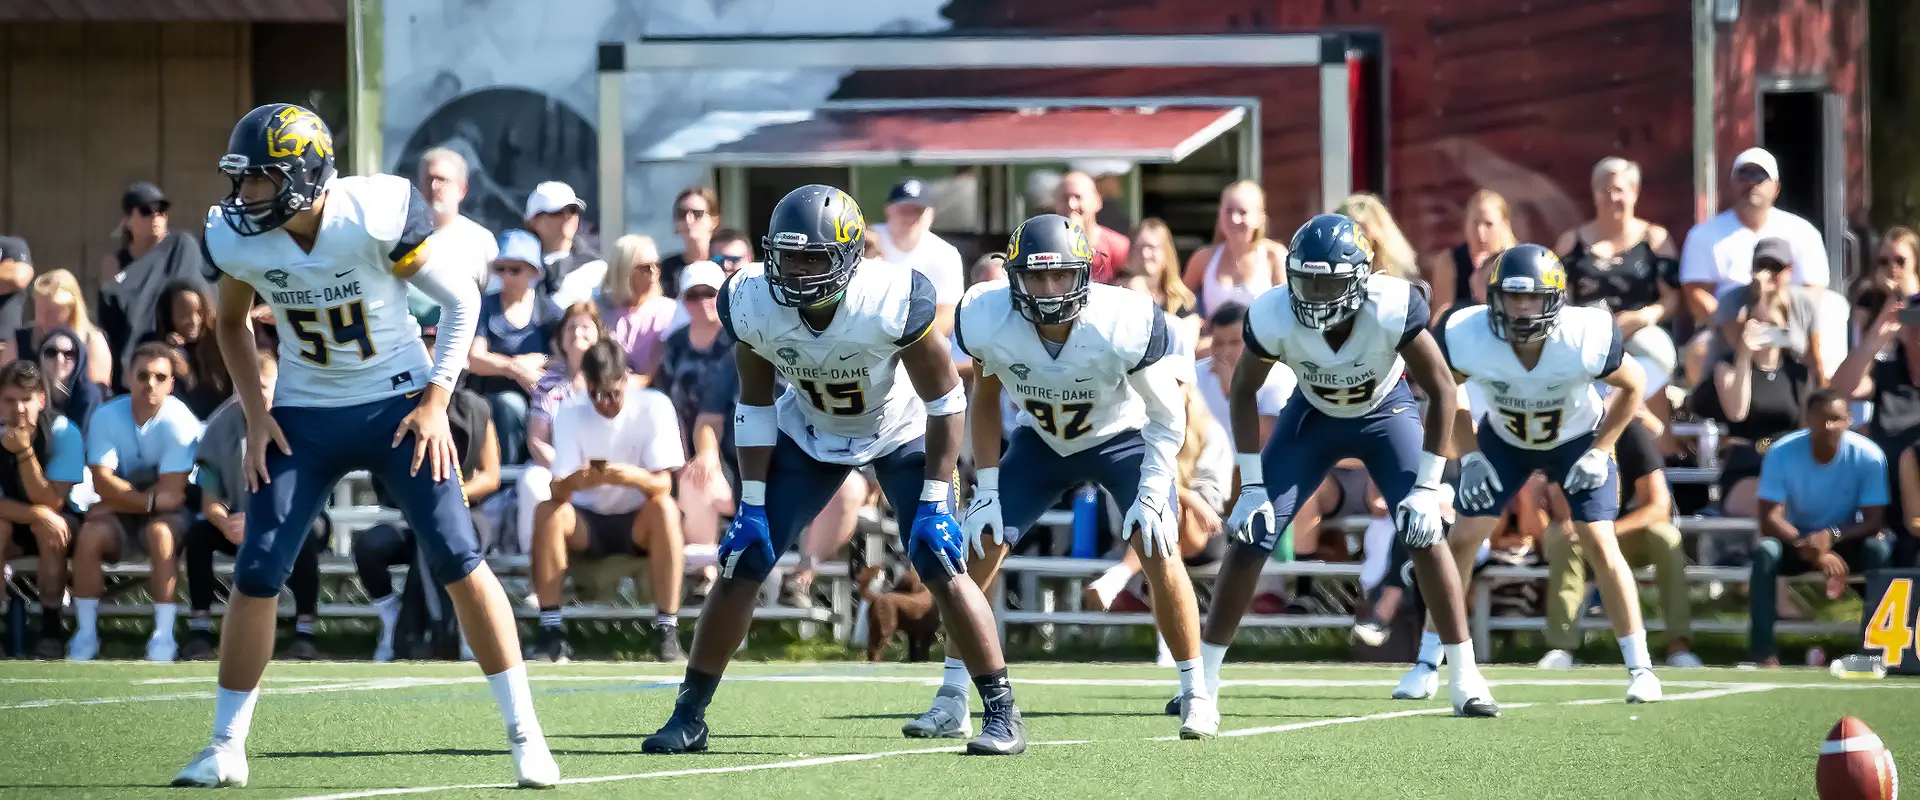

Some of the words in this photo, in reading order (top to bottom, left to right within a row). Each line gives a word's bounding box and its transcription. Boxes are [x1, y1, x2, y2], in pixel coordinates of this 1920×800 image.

[271, 280, 363, 305] NOTRE-DAME
[285, 298, 377, 368] 54
[777, 364, 870, 380] NOTRE-DAME
[1303, 368, 1376, 386] NOTRE-DAME
[798, 378, 867, 416] 15
[1016, 383, 1096, 401] NOTRE-DAME
[1024, 398, 1095, 440] 92
[1498, 406, 1564, 445] 33
[1864, 578, 1920, 668] 4
